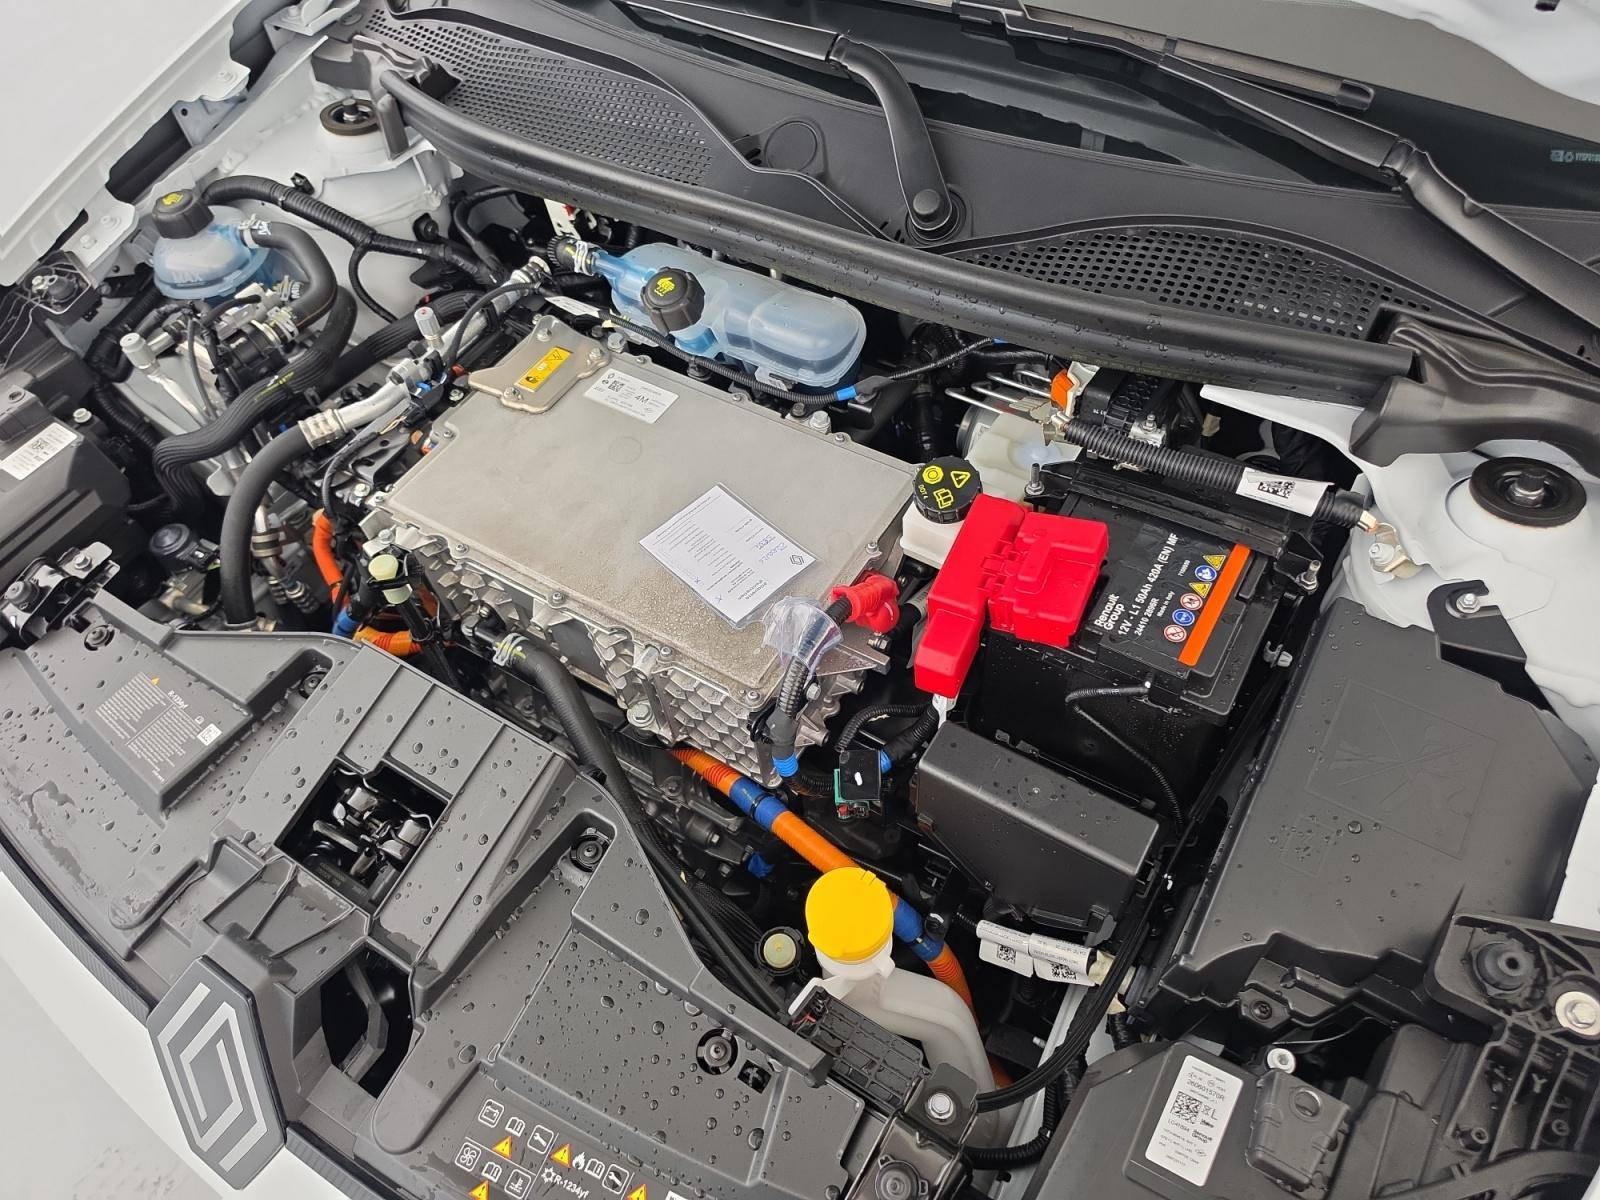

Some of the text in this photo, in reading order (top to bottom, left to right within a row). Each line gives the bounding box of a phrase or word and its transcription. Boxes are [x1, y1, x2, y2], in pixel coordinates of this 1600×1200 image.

[918, 484, 928, 496] DOT
[1166, 533, 1179, 546] MF
[1157, 545, 1176, 564] (EN)
[1146, 563, 1164, 583] 420A
[1135, 583, 1153, 604] 50Ah
[1094, 593, 1120, 628] Renault
[1103, 603, 1126, 631] Group
[1130, 603, 1142, 616] L1
[1118, 620, 1133, 636] 12V
[1134, 616, 1149, 636] 24410
[553, 1174, 589, 1199] R-1234yf
